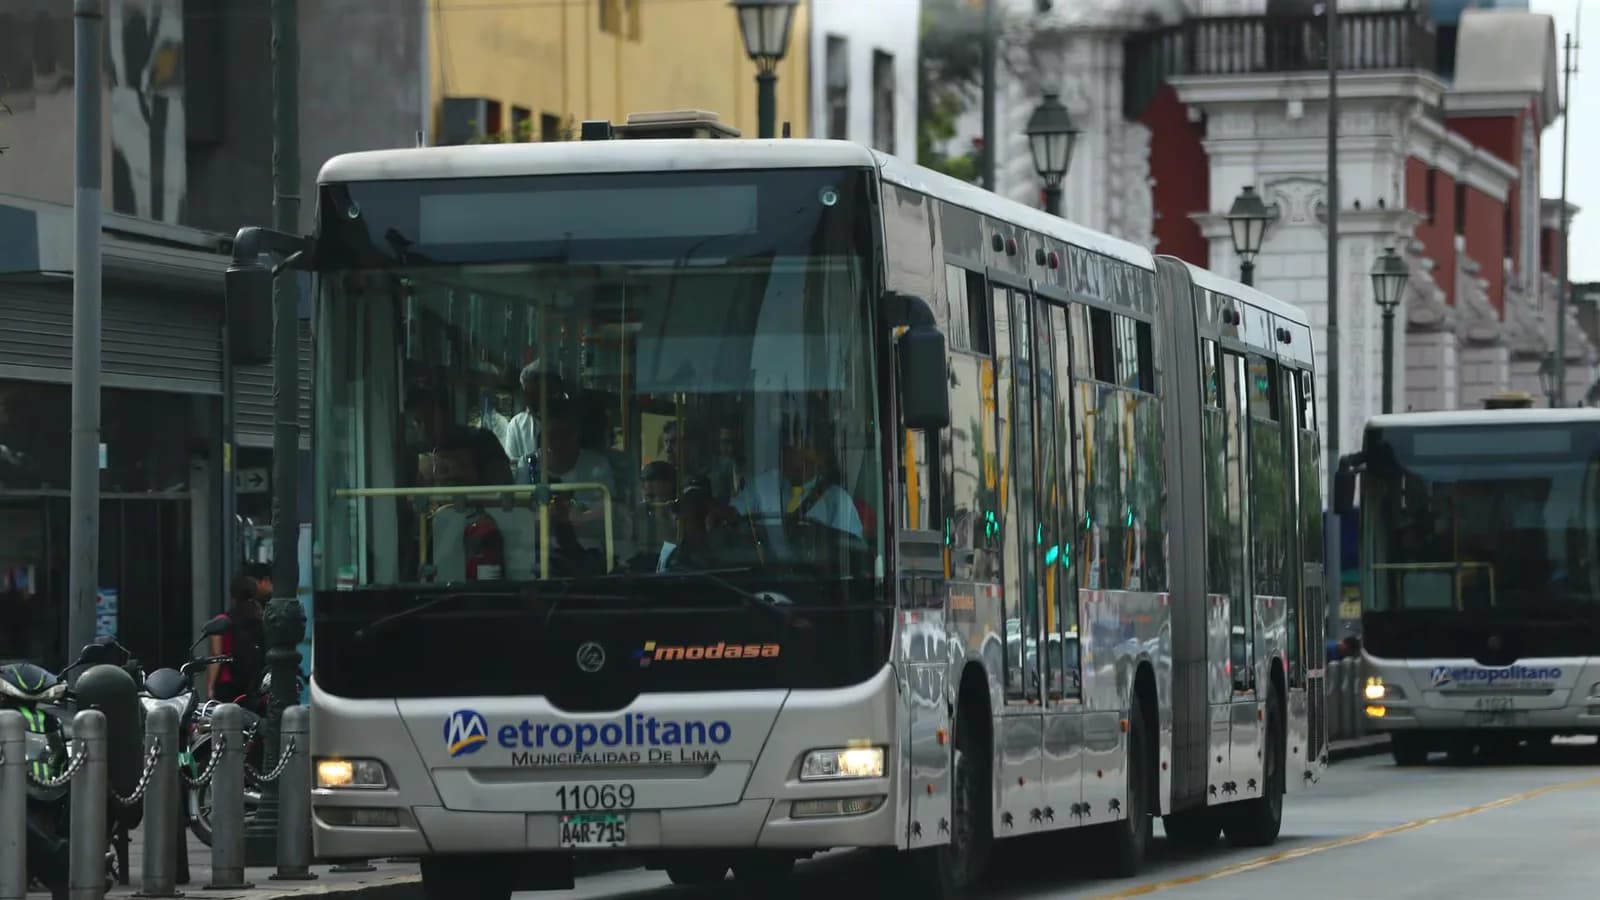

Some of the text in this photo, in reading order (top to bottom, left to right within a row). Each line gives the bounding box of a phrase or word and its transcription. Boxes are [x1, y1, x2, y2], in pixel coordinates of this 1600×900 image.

[654, 641, 781, 661] modasa
[555, 783, 635, 810] 11069
[562, 822, 625, 843] A4R-715
